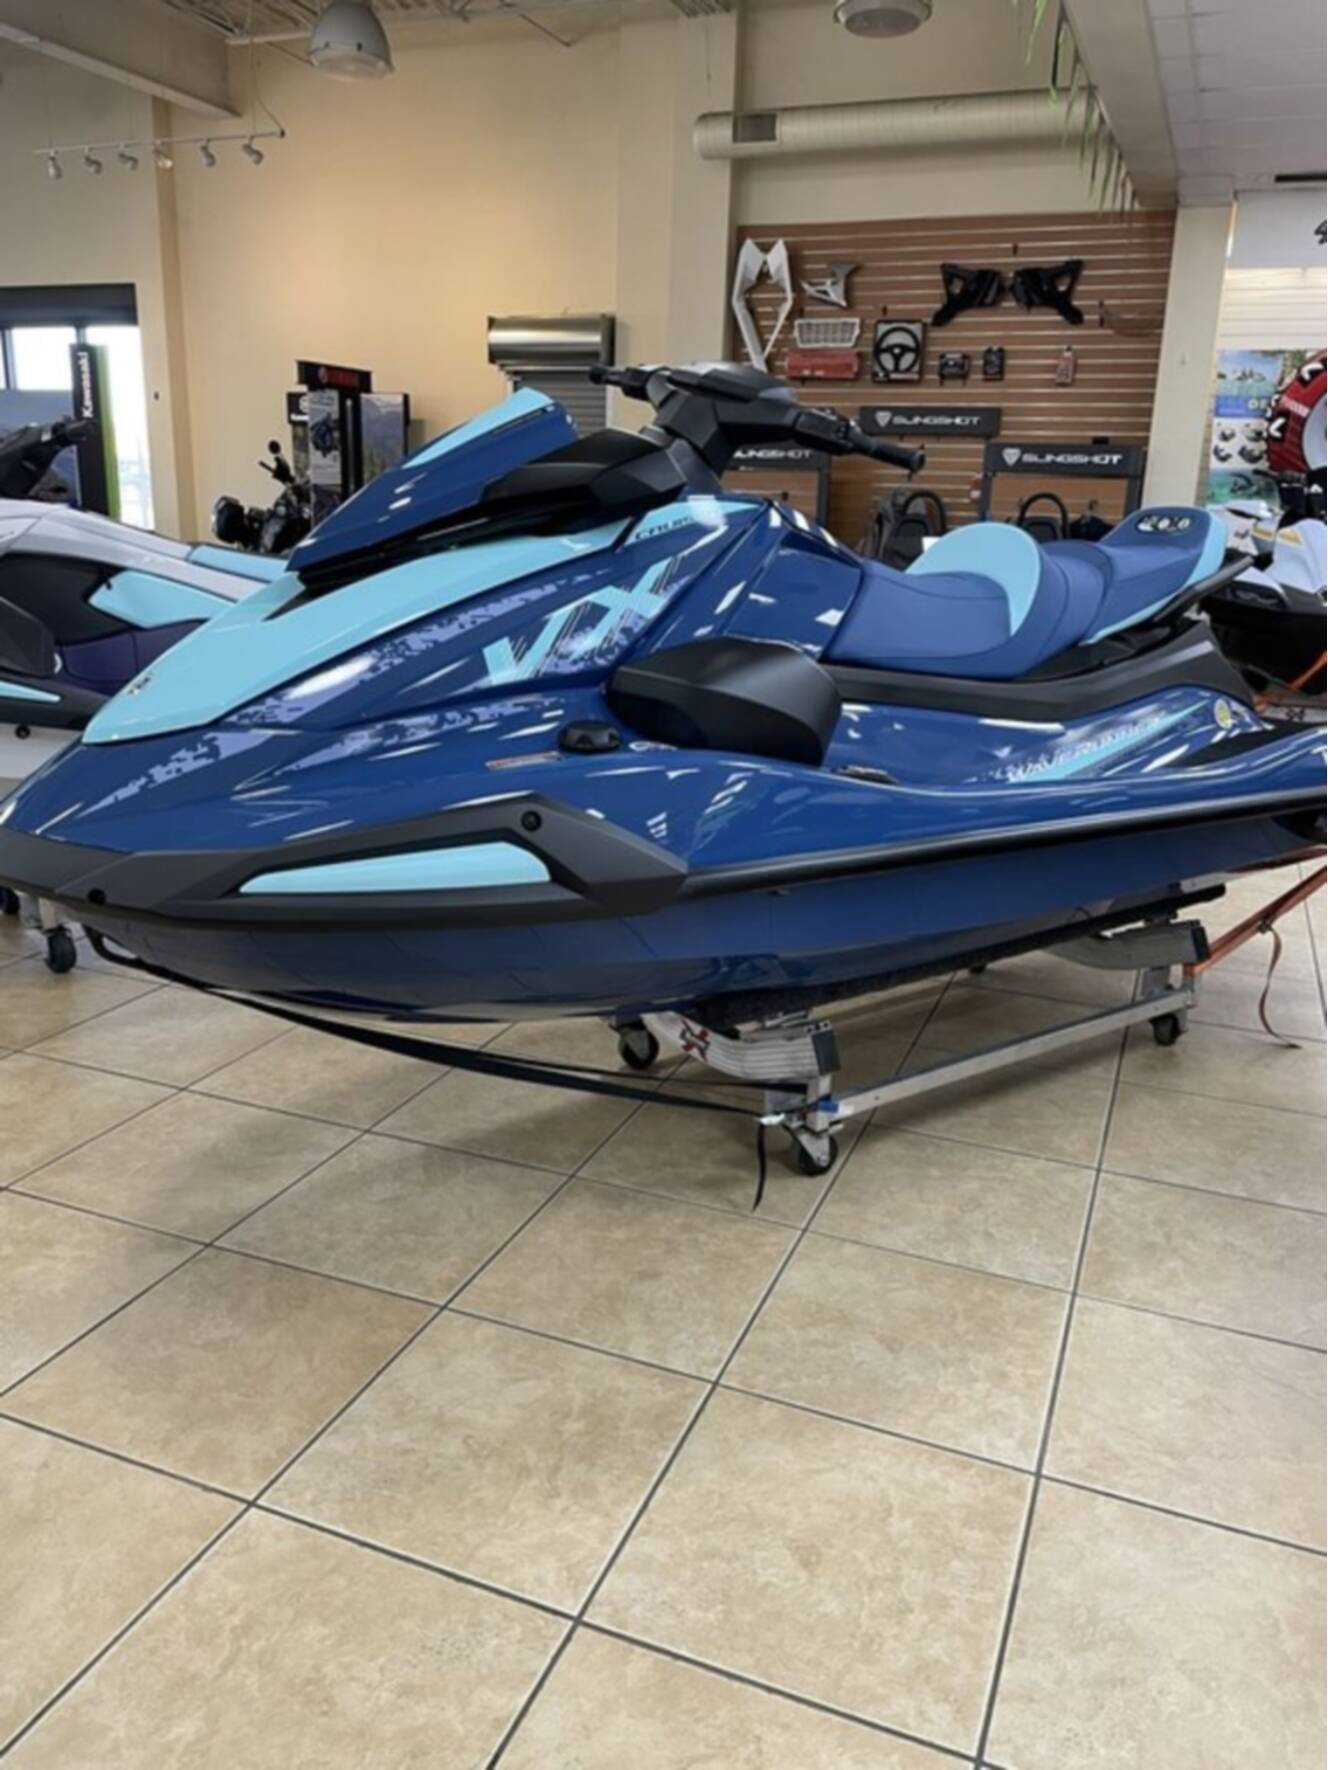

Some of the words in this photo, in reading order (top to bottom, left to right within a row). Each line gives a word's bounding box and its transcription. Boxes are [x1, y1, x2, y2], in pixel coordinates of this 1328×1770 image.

[77, 351, 94, 418] Kawasaki
[892, 415, 981, 426] SLINGSHOT
[732, 448, 812, 459] LINGSHOT
[1021, 453, 1123, 465] SLINGSHOT
